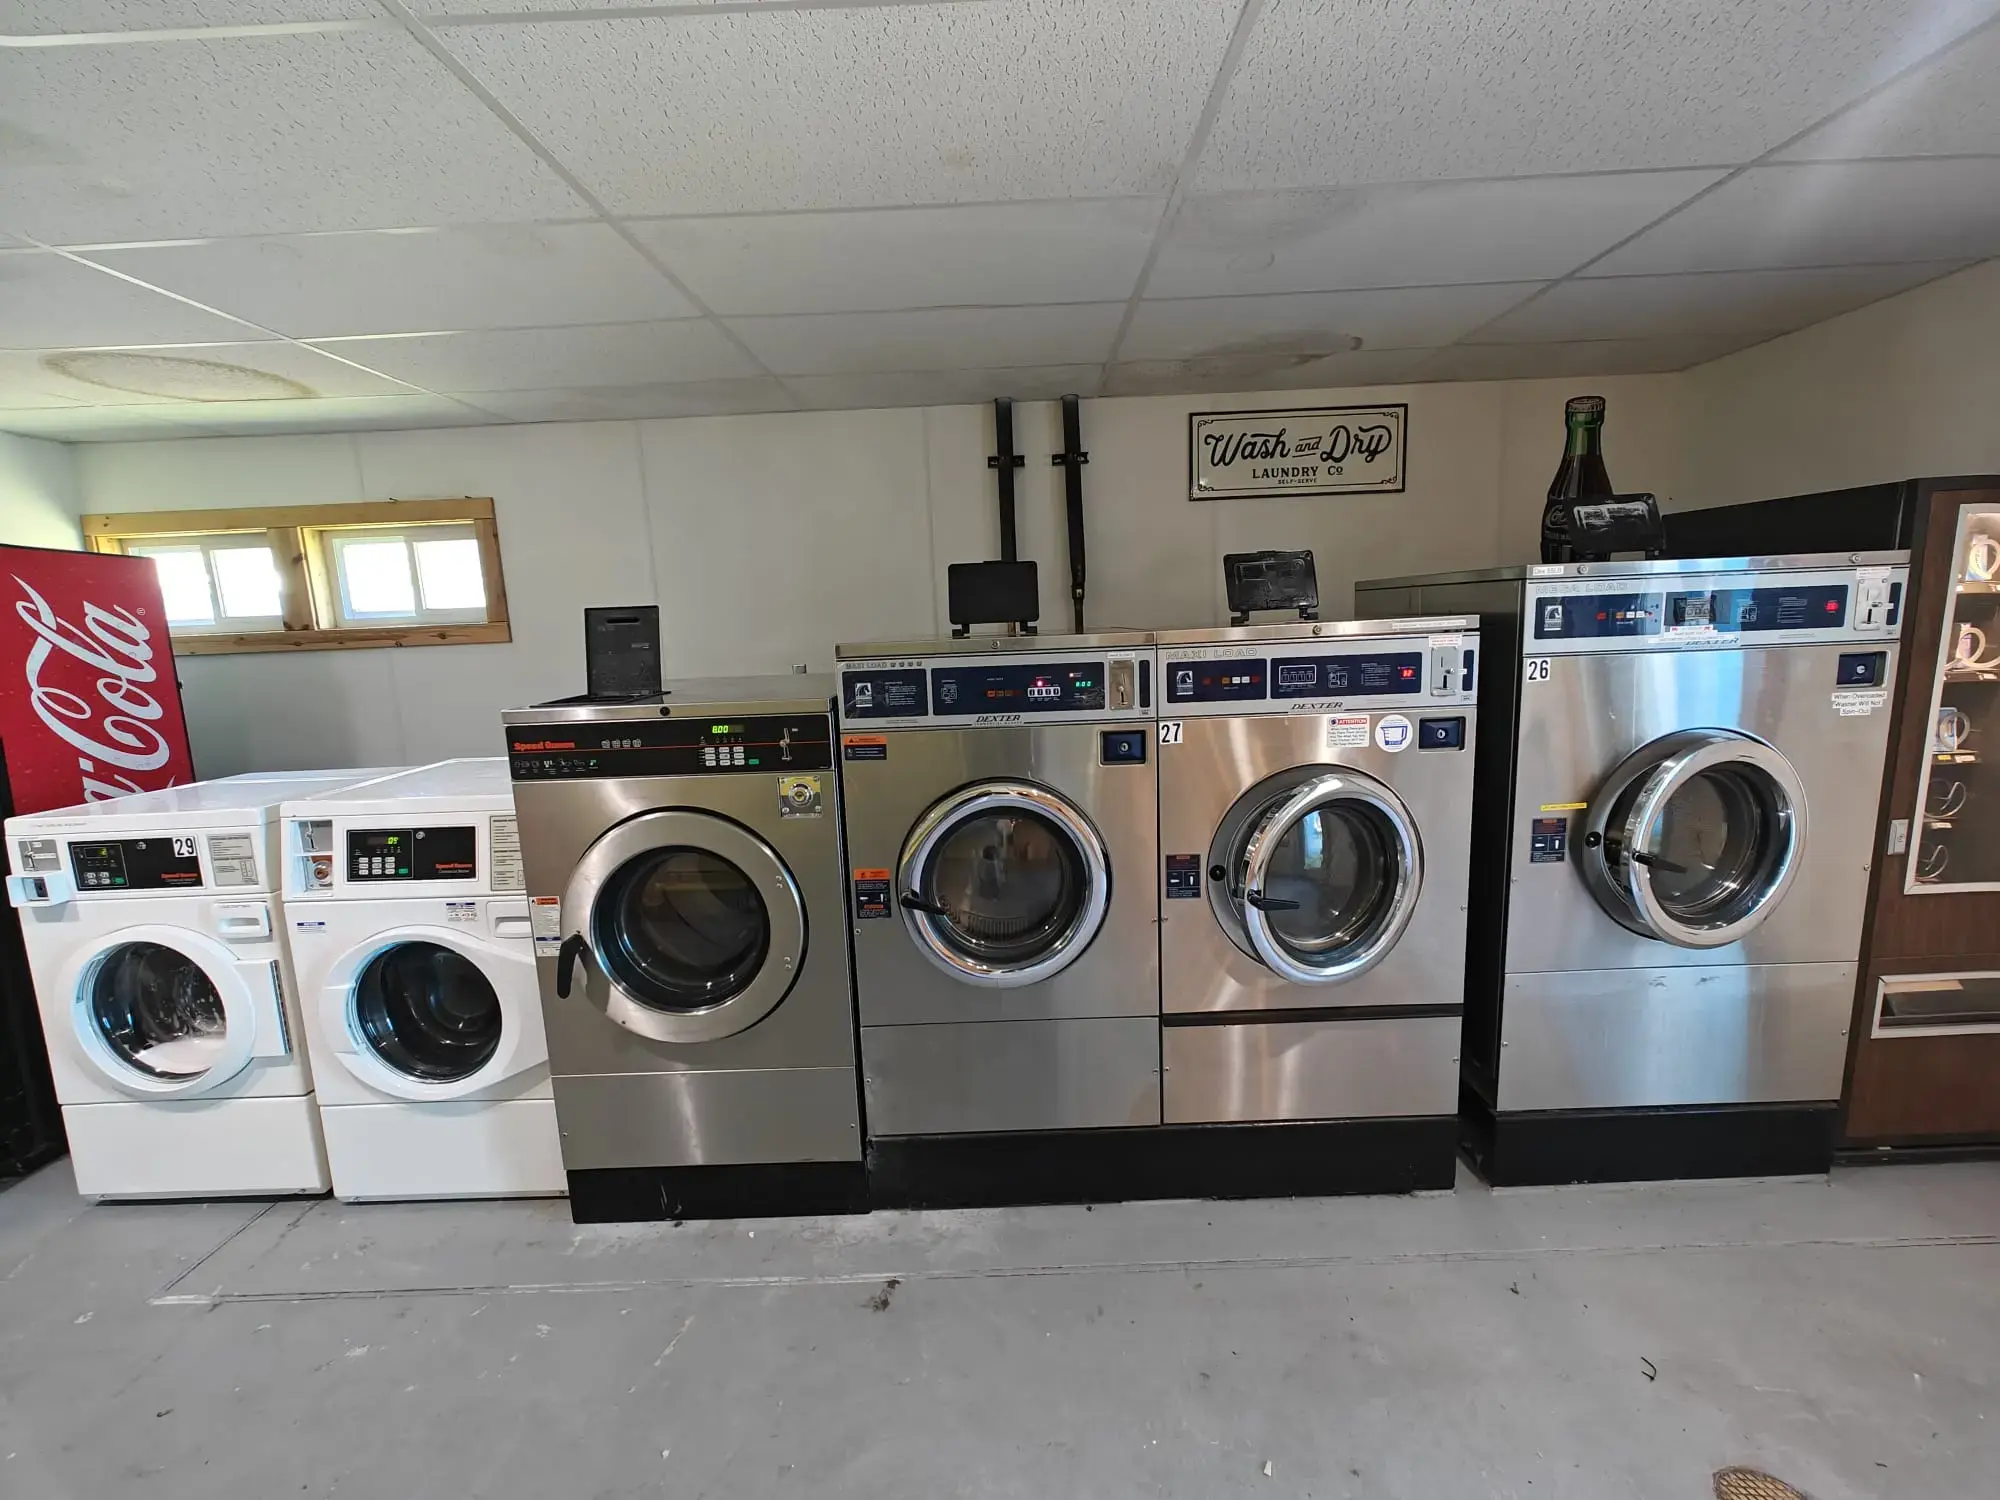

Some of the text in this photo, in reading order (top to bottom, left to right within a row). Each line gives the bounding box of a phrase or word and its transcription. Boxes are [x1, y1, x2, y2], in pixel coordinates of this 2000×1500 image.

[1204, 425, 1392, 467] Wash and Dry
[1252, 465, 1344, 479] LAUNDRY Co
[1585, 582, 1628, 592] LOAD
[1166, 648, 1257, 660] MAXI LOAD
[1528, 660, 1549, 680] 26
[1291, 702, 1343, 711] DEXTER
[976, 714, 1021, 723] DEXTER
[1338, 718, 1367, 726] ATTENTION
[1161, 723, 1182, 743] 27
[514, 741, 575, 752] Speed Queen
[175, 838, 195, 856] 29
